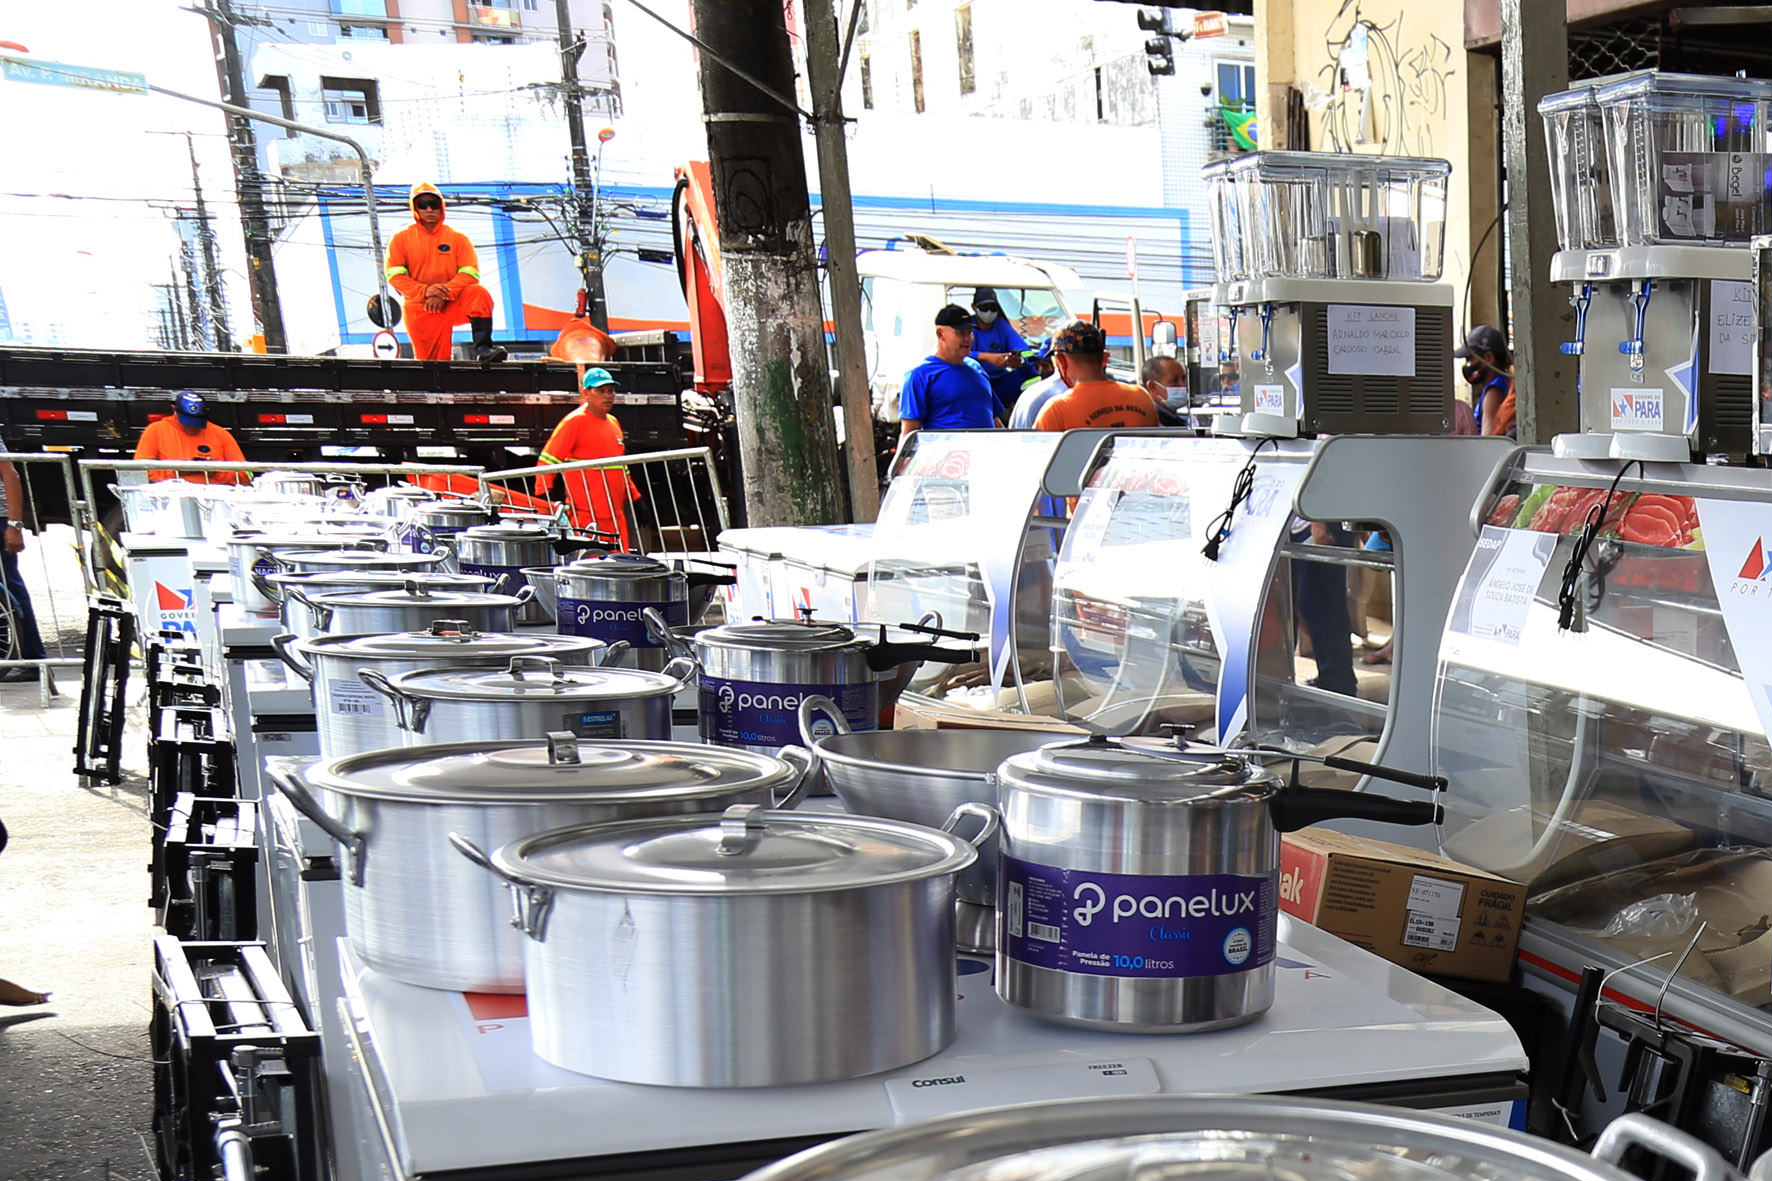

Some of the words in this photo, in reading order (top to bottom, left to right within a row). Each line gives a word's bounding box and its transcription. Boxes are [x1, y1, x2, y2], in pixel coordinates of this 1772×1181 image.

[1332, 329, 1370, 340] ARNALDO
[1333, 344, 1368, 355] CARDOSO
[1373, 345, 1402, 355] CABRAL
[1478, 538, 1502, 550] SEDAP
[1730, 583, 1759, 596] POR
[1485, 590, 1504, 601] SOUZA
[1504, 594, 1528, 605] BATISTA
[1480, 889, 1516, 901] CUIDADO
[1113, 888, 1255, 923] panelux
[1478, 897, 1513, 912] FRÁGIL
[1149, 926, 1193, 941] Classic
[1072, 950, 1098, 959] Panela
[1100, 952, 1110, 960] de
[1228, 946, 1249, 954] BRASIL
[1080, 958, 1110, 967] Pressão
[1113, 955, 1145, 970] 10,0
[1145, 958, 1174, 969] litros
[1088, 1063, 1124, 1071] FREEZER
[911, 1075, 966, 1088] Consul
